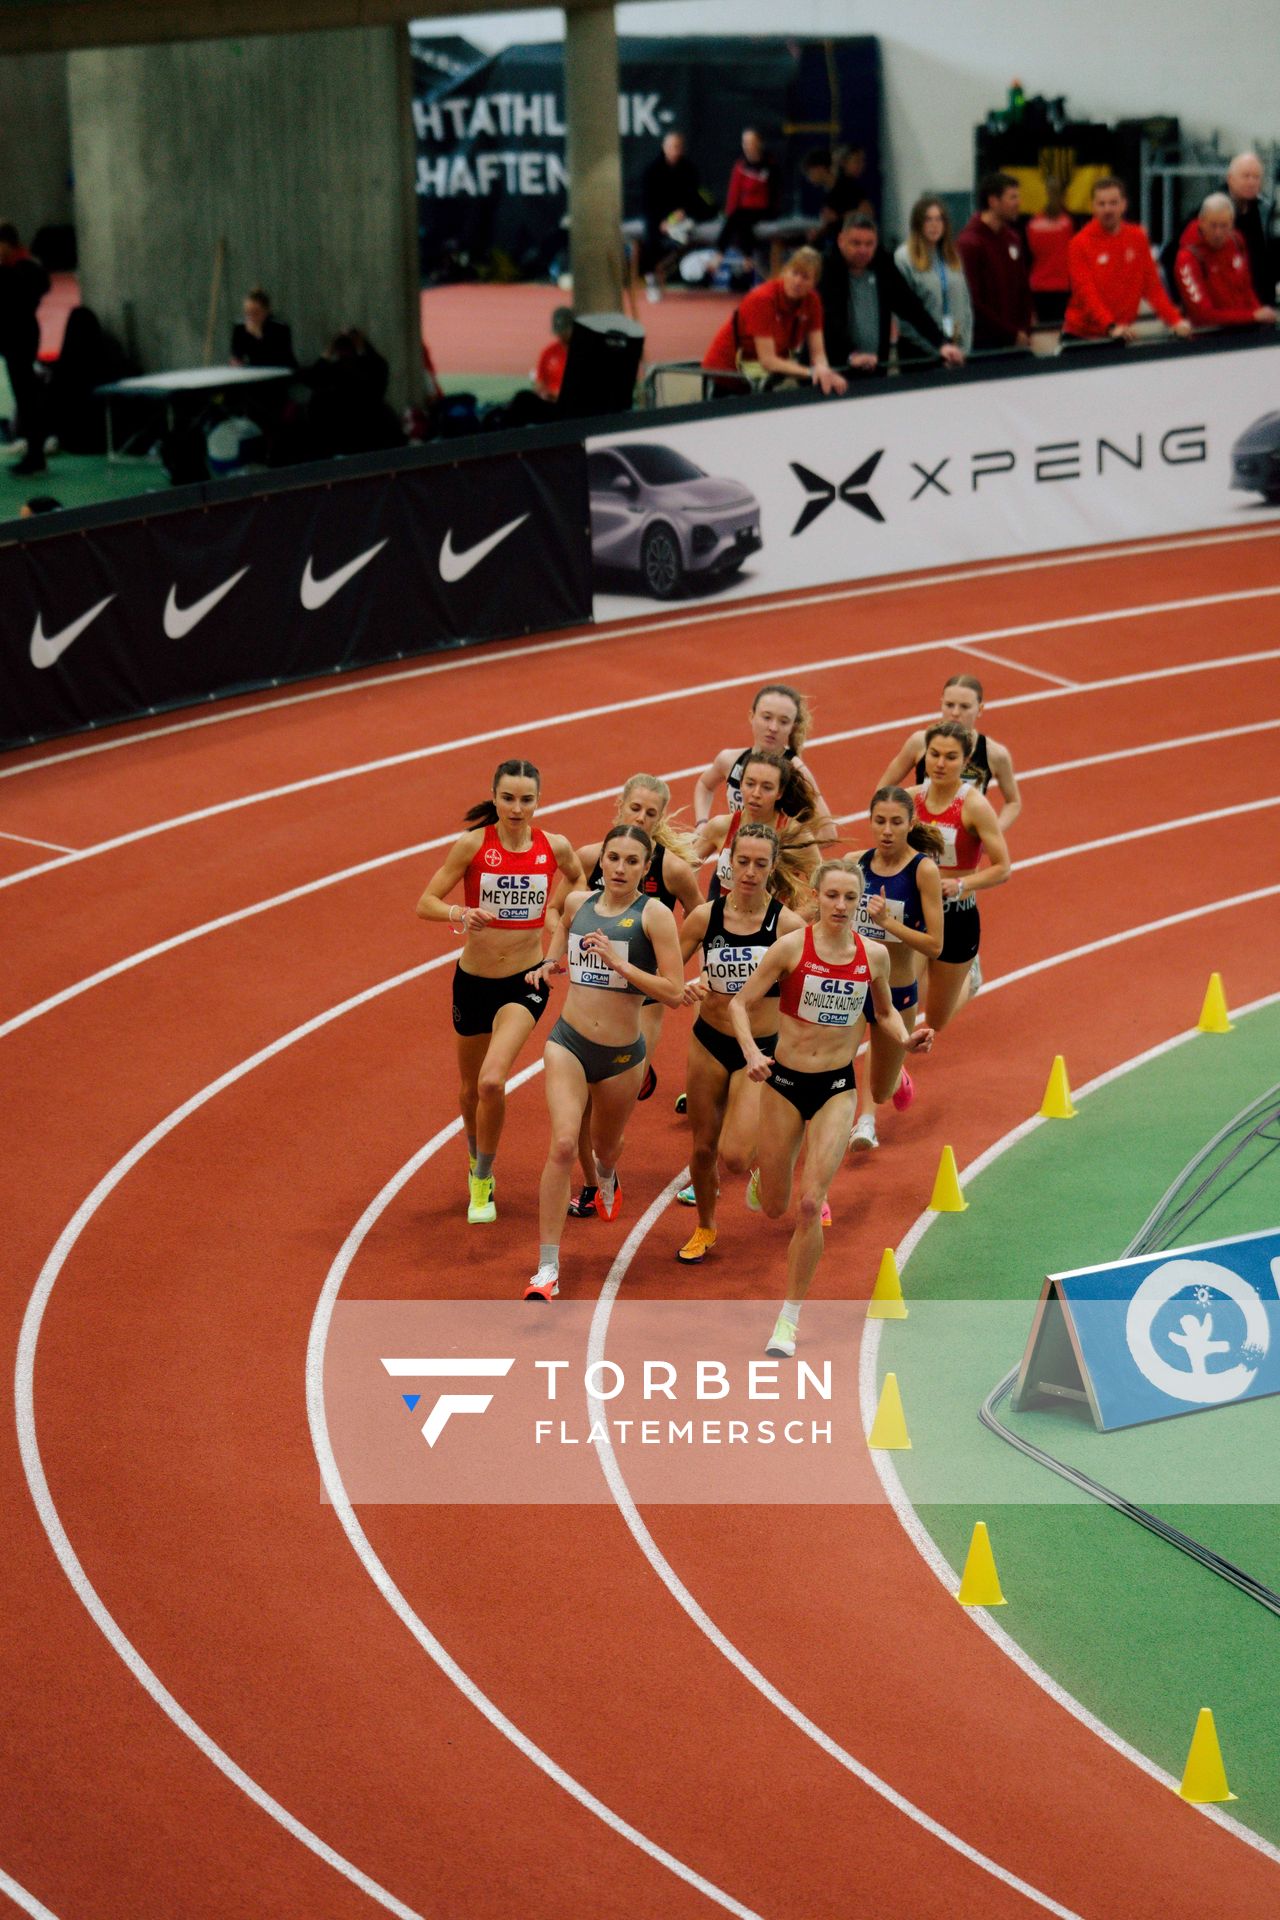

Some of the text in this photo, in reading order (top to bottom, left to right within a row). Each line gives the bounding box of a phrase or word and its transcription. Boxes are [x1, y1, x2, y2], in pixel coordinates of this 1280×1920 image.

[412, 93, 674, 141] HTATHLIK-
[415, 152, 570, 197] HAFTEN
[910, 425, 1207, 501] XPENG
[497, 875, 530, 889] GLS
[482, 889, 545, 905] MEYBERG
[569, 950, 615, 971] L.MILL
[719, 948, 752, 962] GLS
[821, 979, 854, 995] GLS
